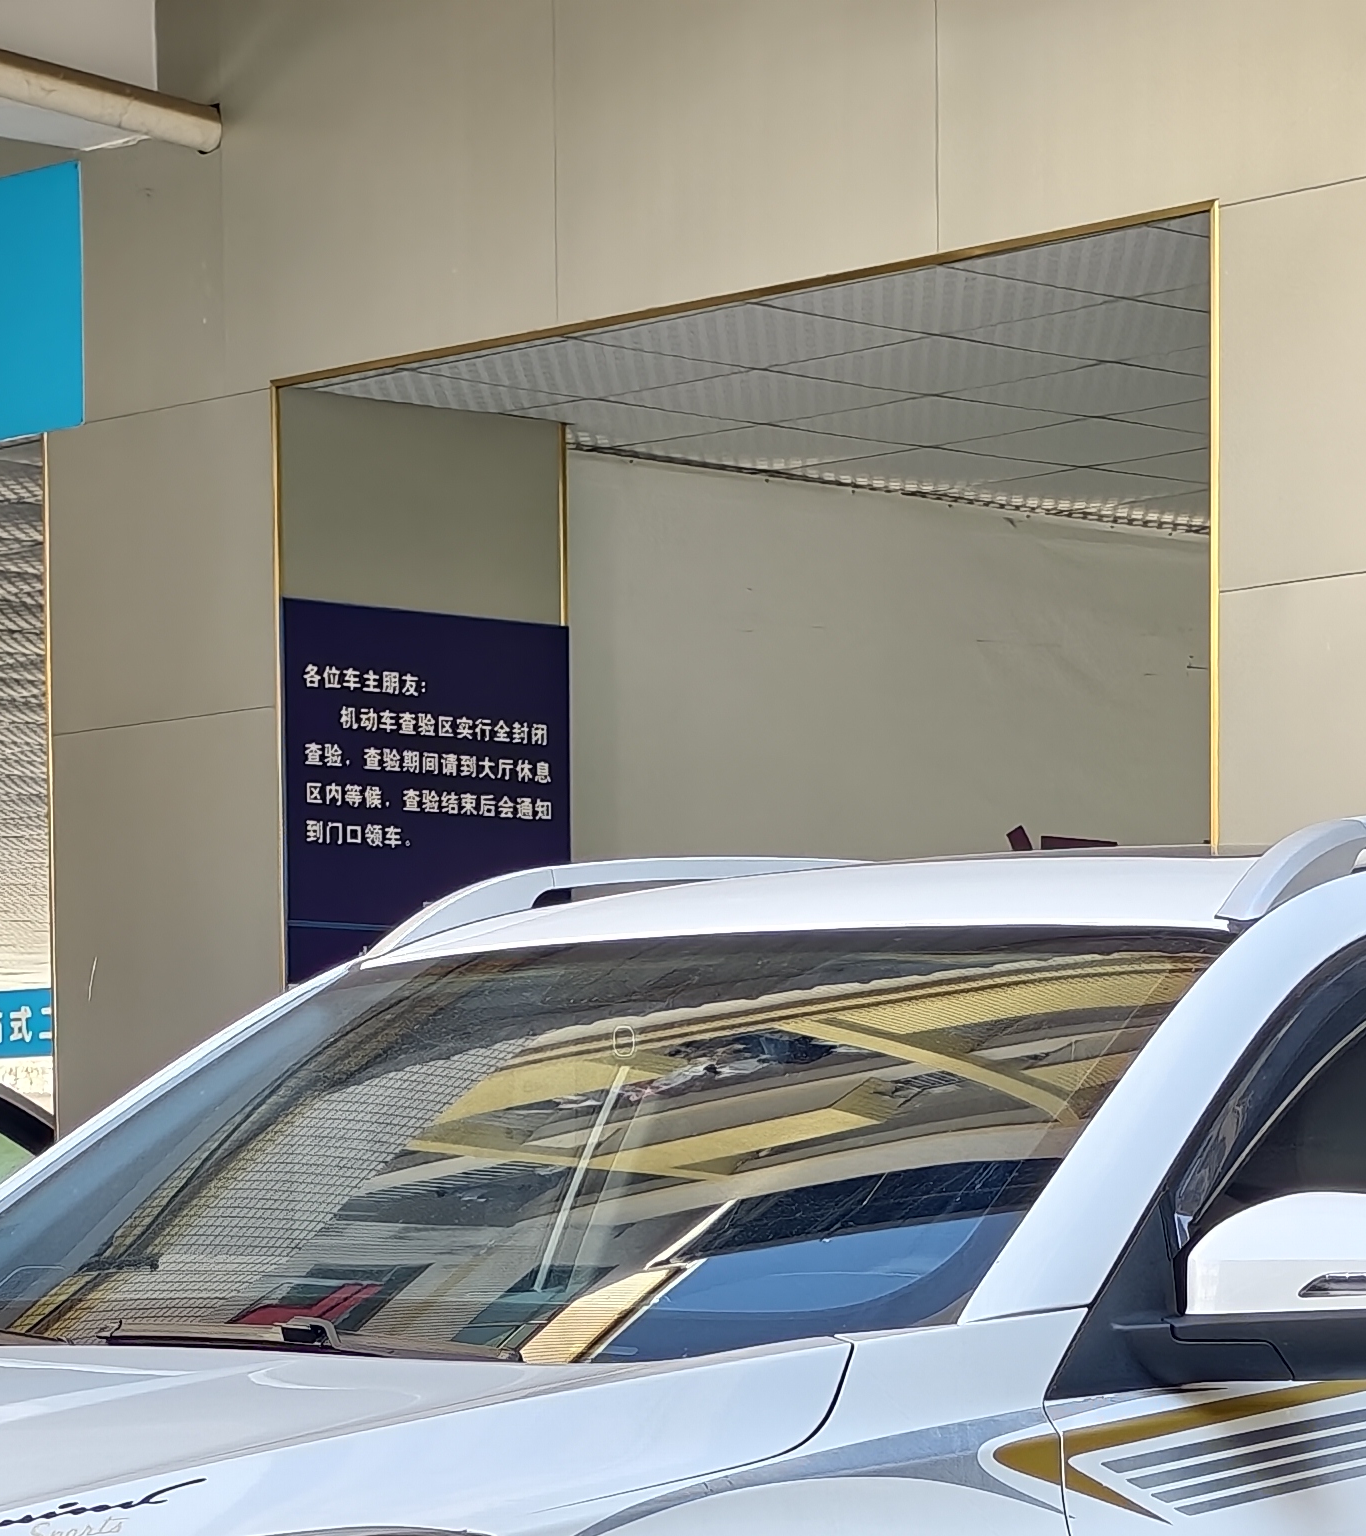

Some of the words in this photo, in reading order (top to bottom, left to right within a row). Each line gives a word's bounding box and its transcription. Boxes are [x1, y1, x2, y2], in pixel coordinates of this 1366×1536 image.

[339, 706, 549, 746] 机动车查验区实行全封闭
